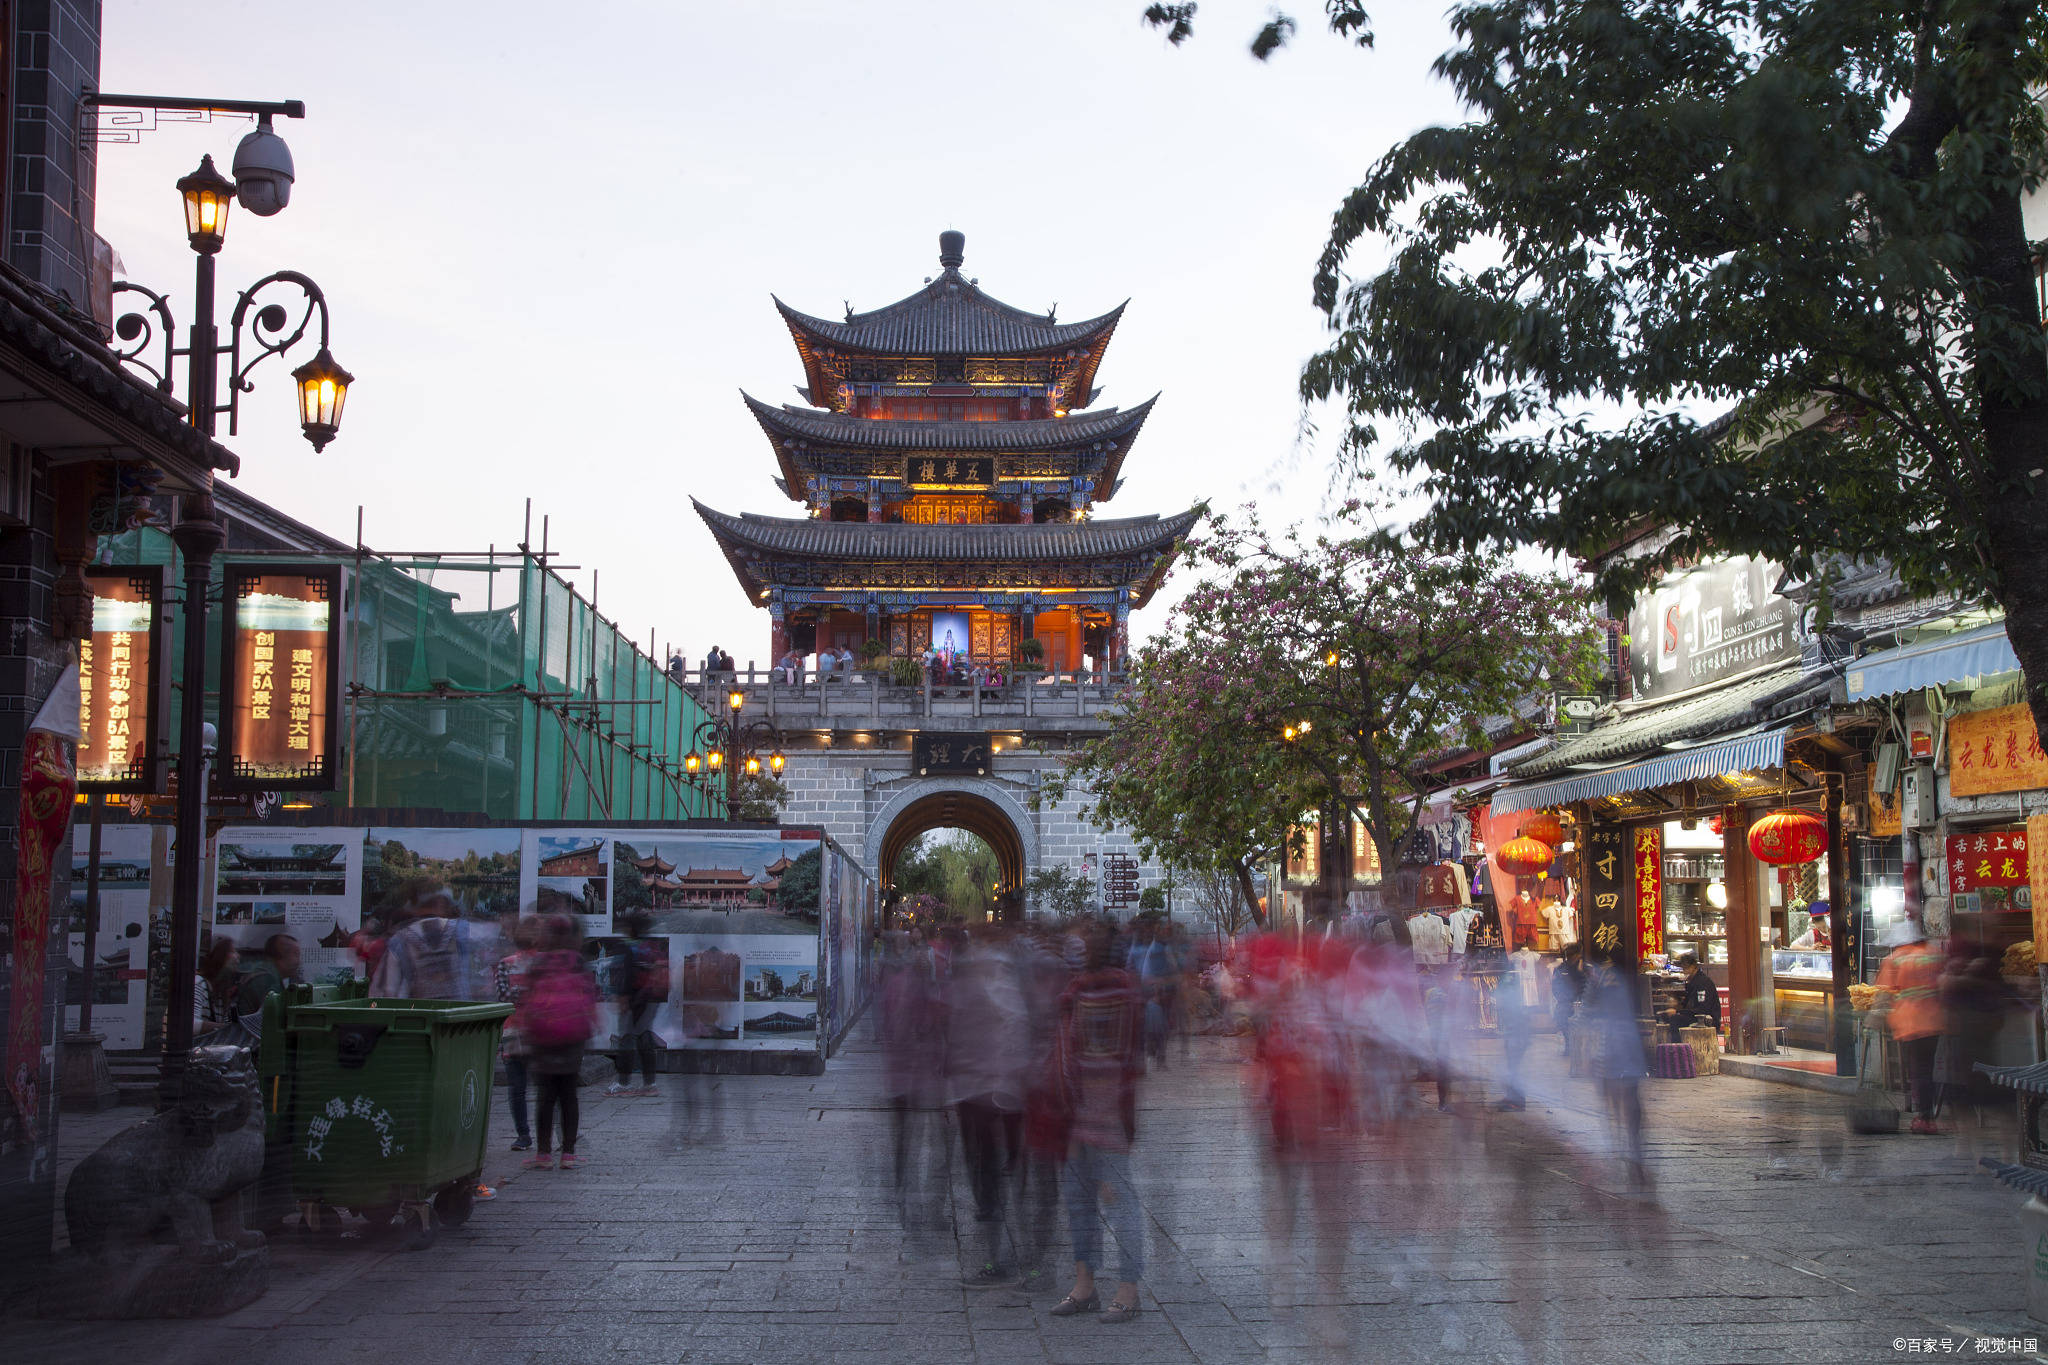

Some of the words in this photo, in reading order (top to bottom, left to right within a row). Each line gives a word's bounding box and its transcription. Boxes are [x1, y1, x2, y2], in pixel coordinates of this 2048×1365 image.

[107, 631, 131, 764] 共同行动争创5A景区
[251, 631, 275, 720] 创国家5A景区
[287, 648, 313, 750] 建文明和谐大理
[1954, 835, 2026, 854] 舌尖上的
[1975, 857, 2031, 879] 云龙
